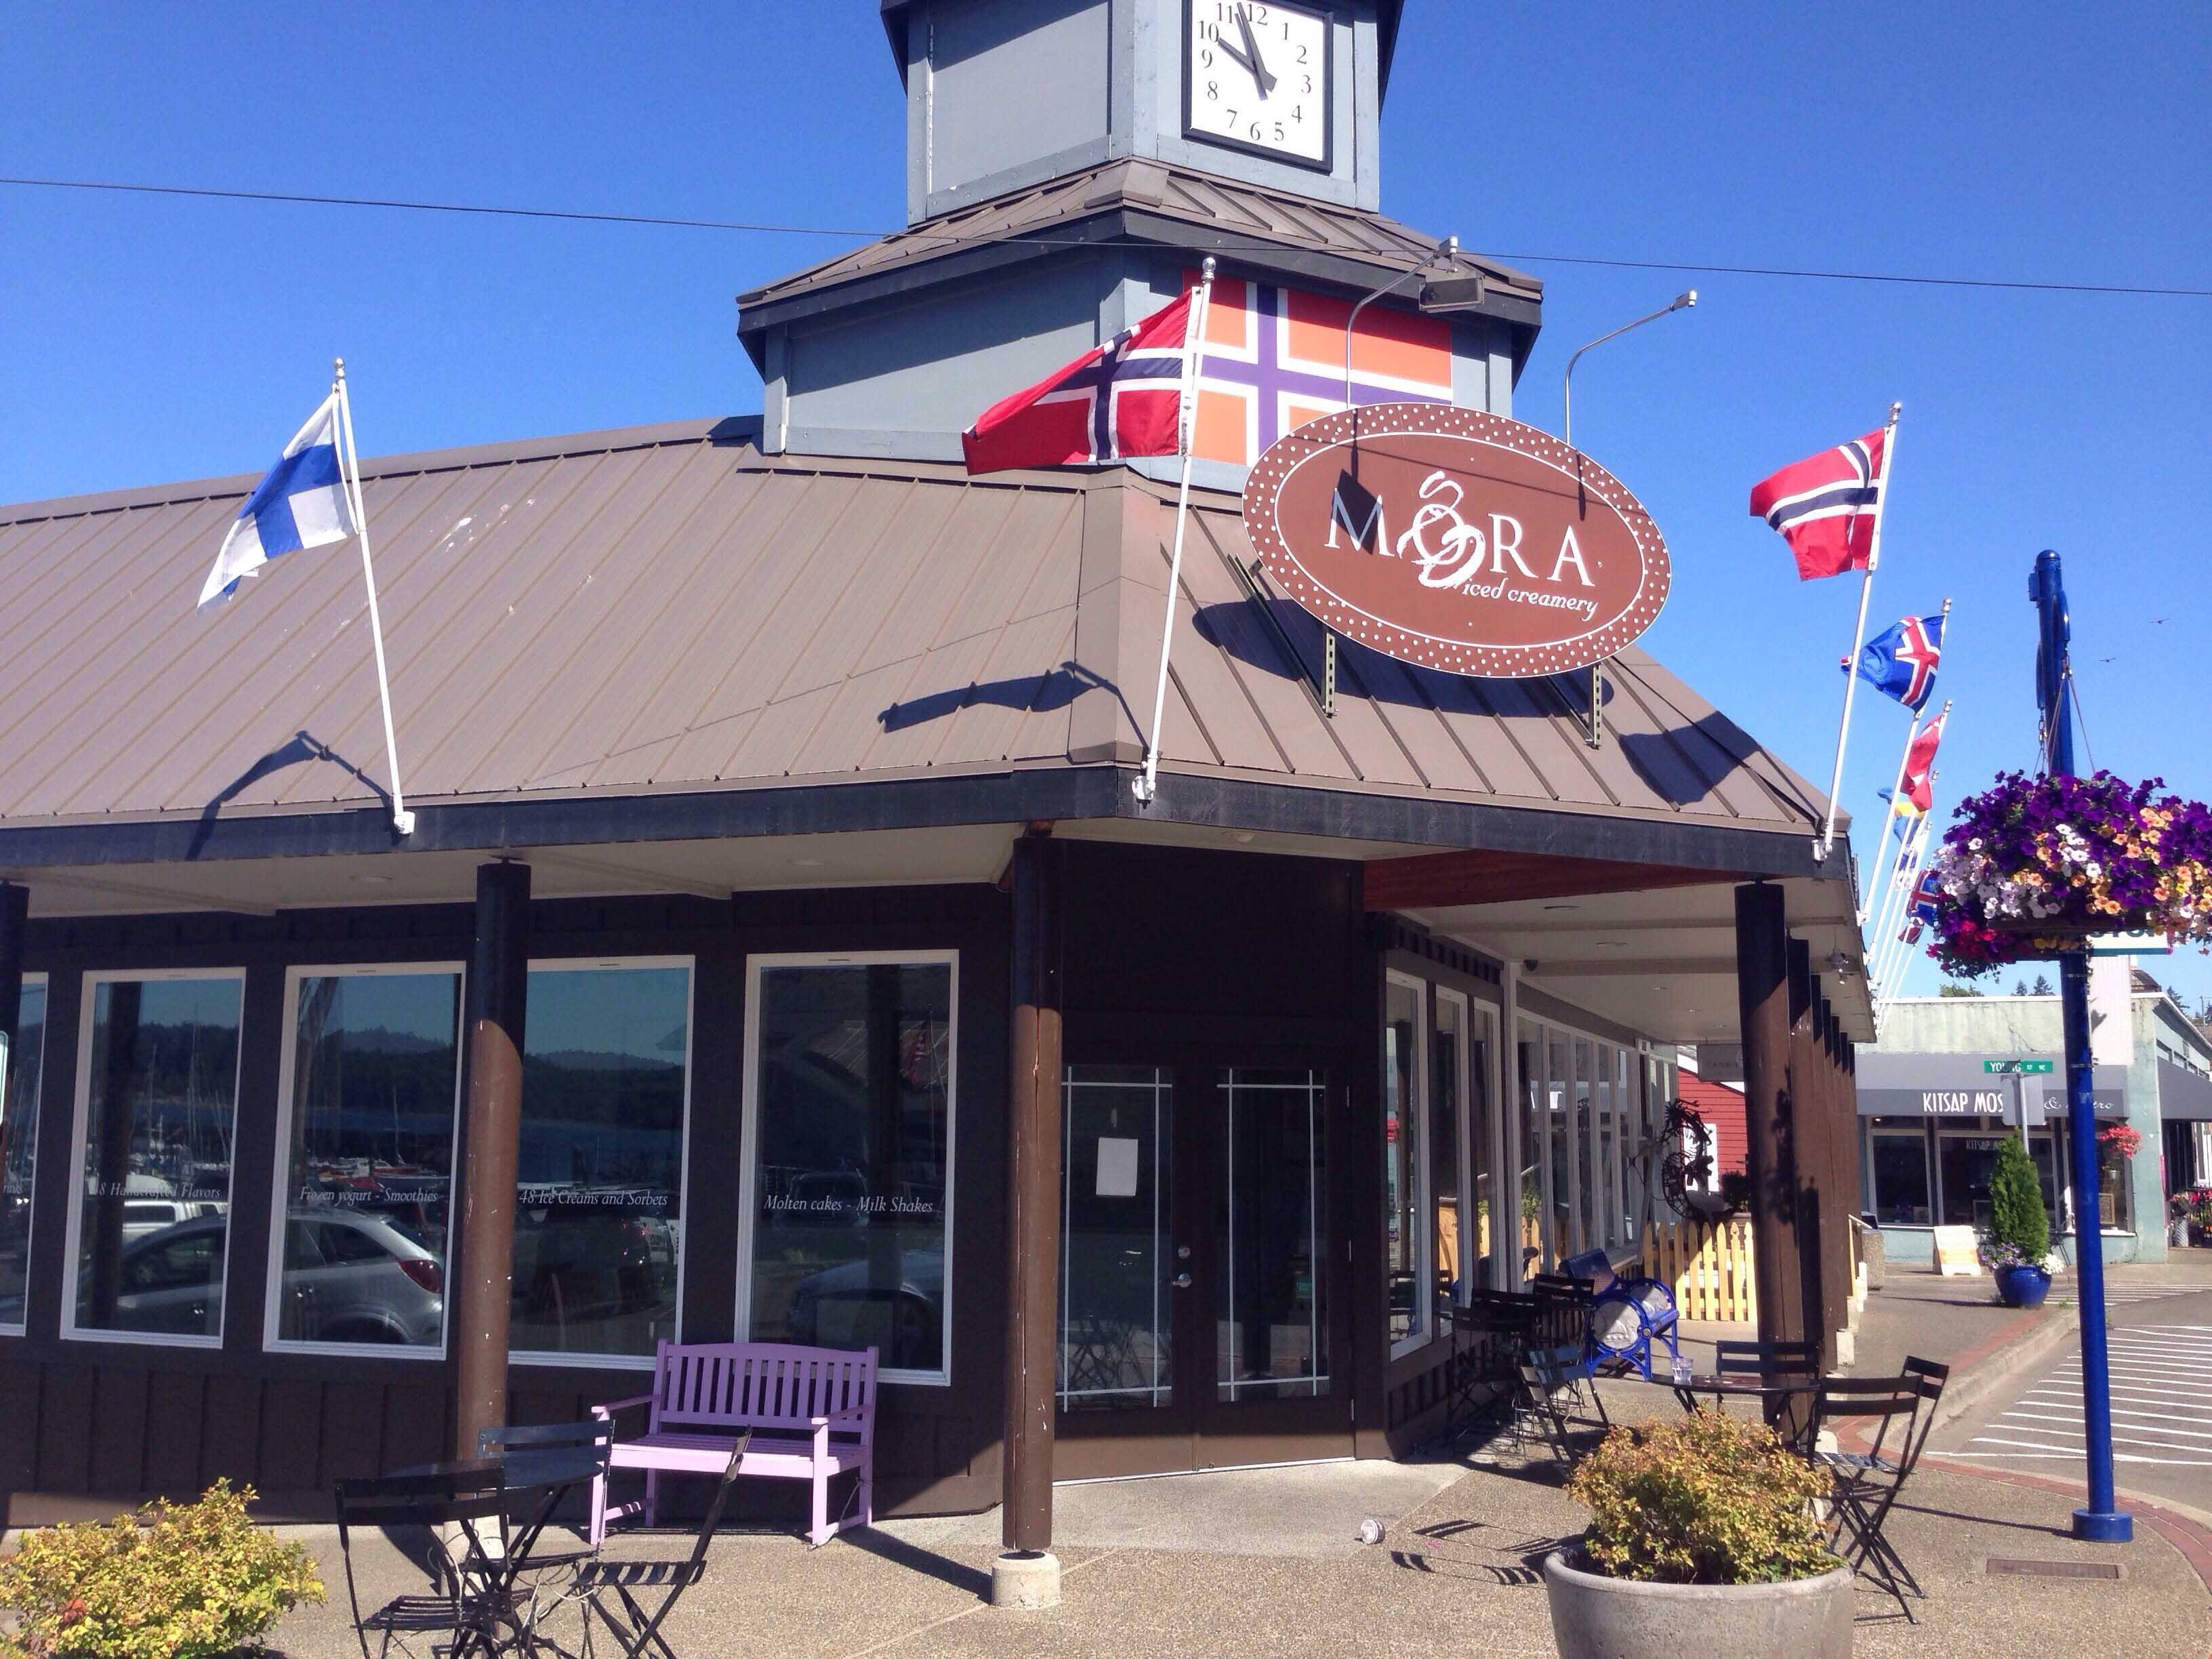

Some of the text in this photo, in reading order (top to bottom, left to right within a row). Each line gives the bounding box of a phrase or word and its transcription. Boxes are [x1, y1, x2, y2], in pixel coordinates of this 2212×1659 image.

[1216, 2, 1233, 24] 11
[1247, 3, 1268, 26] 12
[1197, 20, 1219, 43] 10
[1282, 22, 1288, 41] 1
[1202, 49, 1213, 68] 9
[1296, 45, 1307, 64] 2
[1207, 81, 1218, 100] 8
[1300, 75, 1311, 94] 3
[1227, 108, 1237, 128] 7
[1291, 104, 1303, 123] 4
[1250, 121, 1261, 141] 6
[1274, 122, 1284, 141] 5
[1324, 472, 1596, 587] MORA
[1462, 577, 1599, 621] iced creamery
[1990, 1062, 2021, 1072] YOG
[1923, 1092, 1968, 1112] KITSAP
[181, 1181, 222, 1198] Flavors
[300, 1187, 335, 1201] Frozen
[334, 1190, 372, 1206] yogurt
[384, 1187, 438, 1202] Smoothies
[519, 1190, 668, 1206] 48 Ice Creams and Sorbets
[764, 1195, 807, 1210] Molten
[811, 1195, 843, 1211] cakes
[856, 1196, 887, 1212] Milk
[890, 1197, 933, 1213] Shakes
